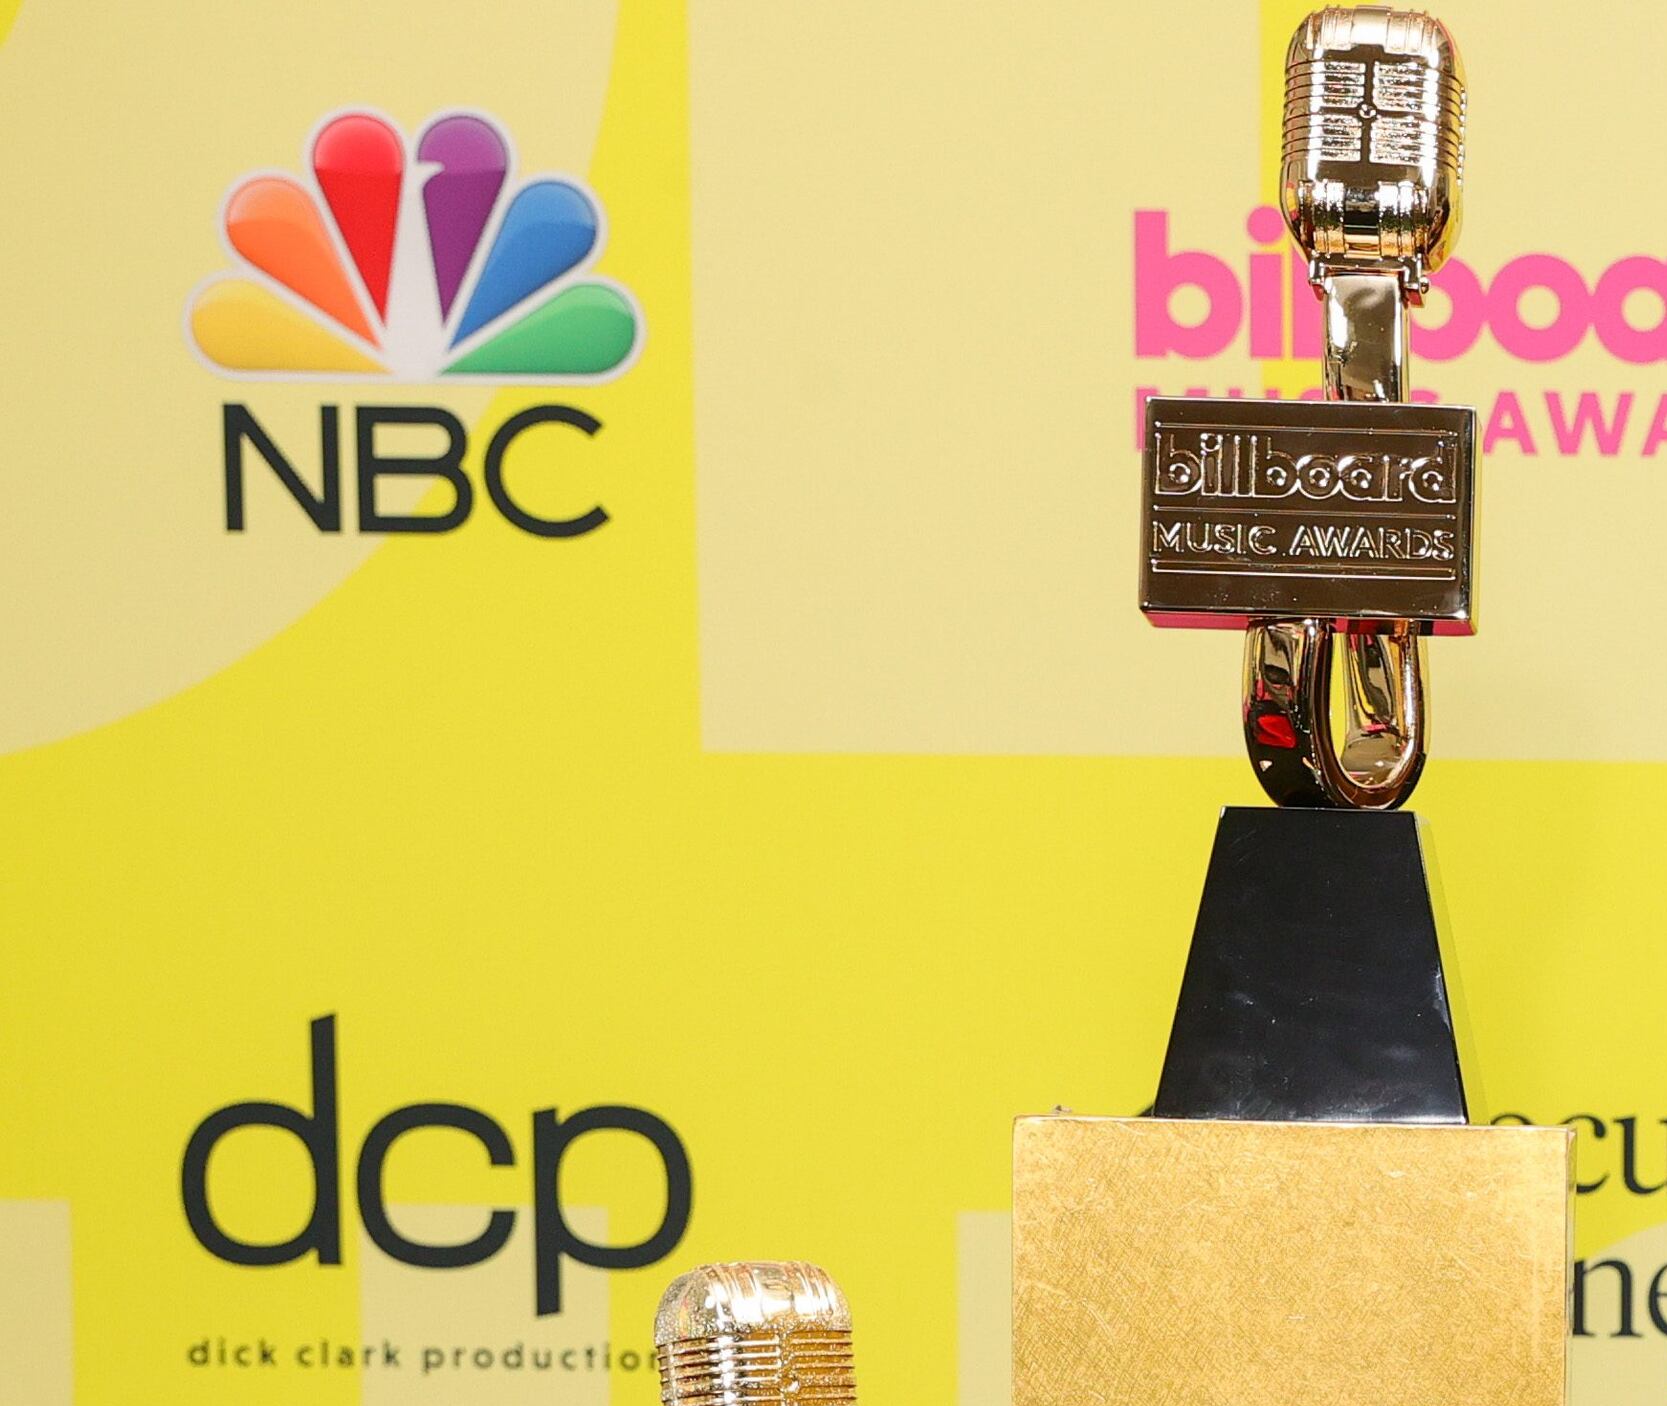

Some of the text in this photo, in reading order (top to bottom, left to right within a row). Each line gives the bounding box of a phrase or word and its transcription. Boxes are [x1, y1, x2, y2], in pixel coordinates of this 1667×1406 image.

[222, 401, 610, 540] NBC
[1153, 431, 1457, 504] billboard
[1151, 520, 1456, 561] MUSIC AWARDS
[180, 1012, 694, 1319] dcp
[186, 1336, 278, 1369] dick
[294, 1338, 402, 1371] clark
